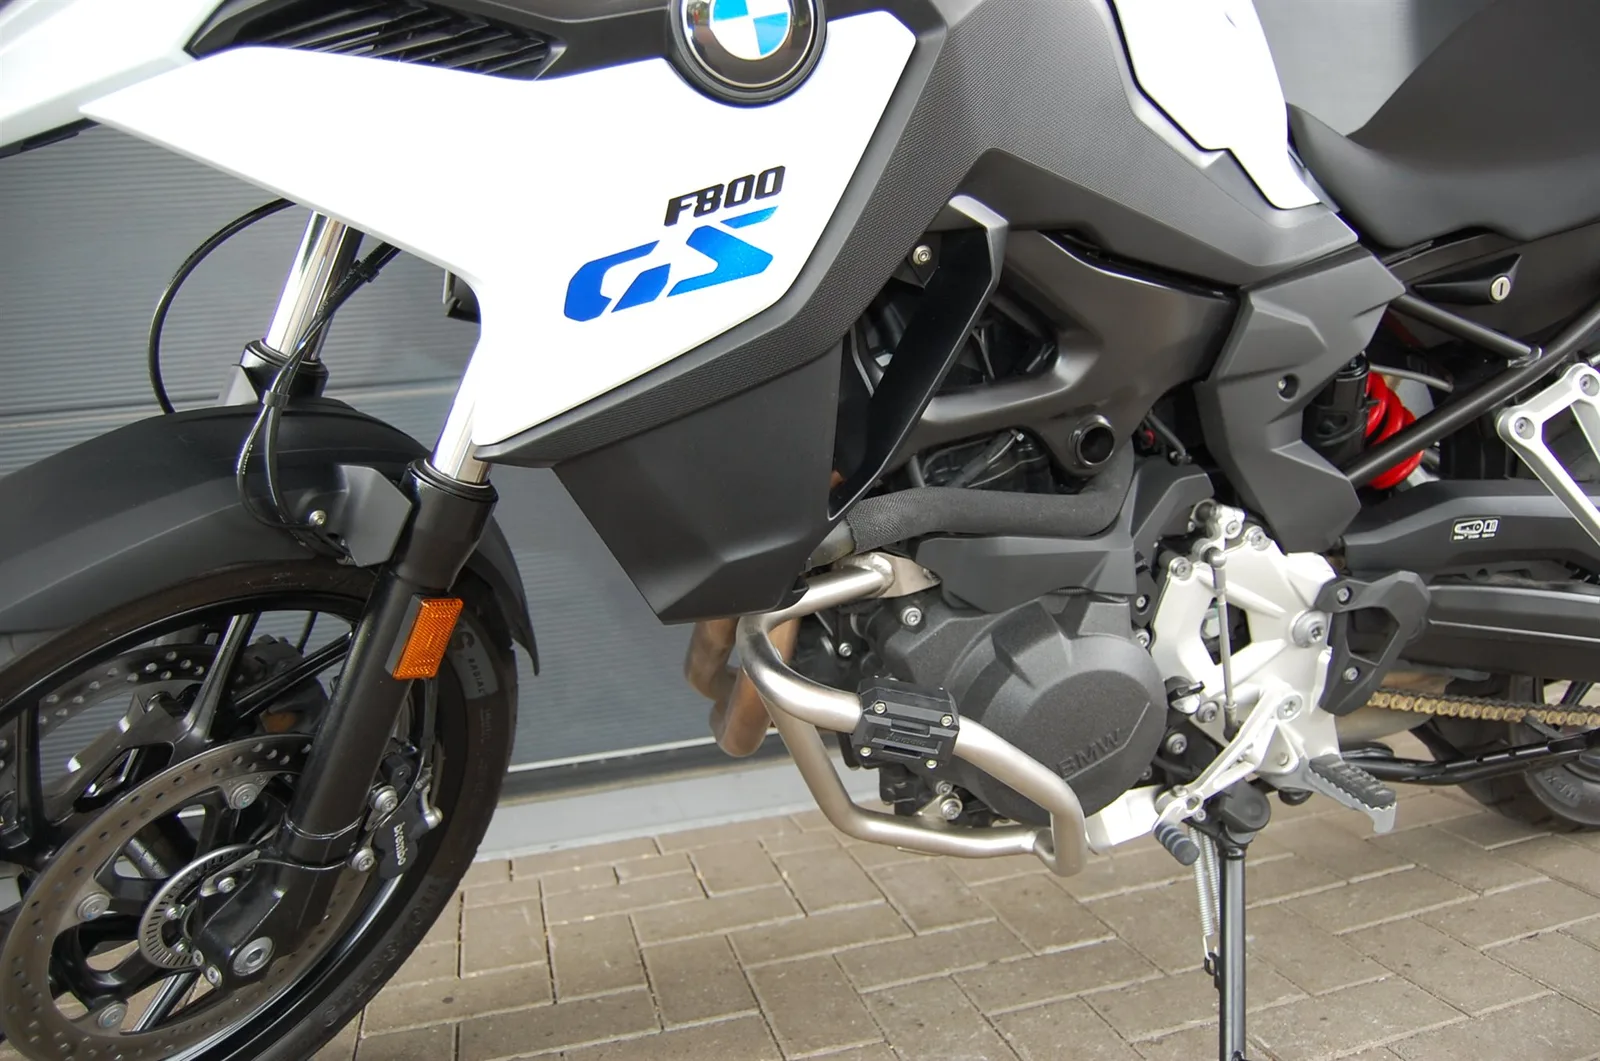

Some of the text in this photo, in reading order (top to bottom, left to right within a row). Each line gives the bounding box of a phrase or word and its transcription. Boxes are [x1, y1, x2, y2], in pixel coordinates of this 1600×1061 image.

[664, 165, 786, 227] F800
[563, 205, 779, 322] GS
[1056, 727, 1120, 780] BMW
[393, 821, 408, 866] brembo
